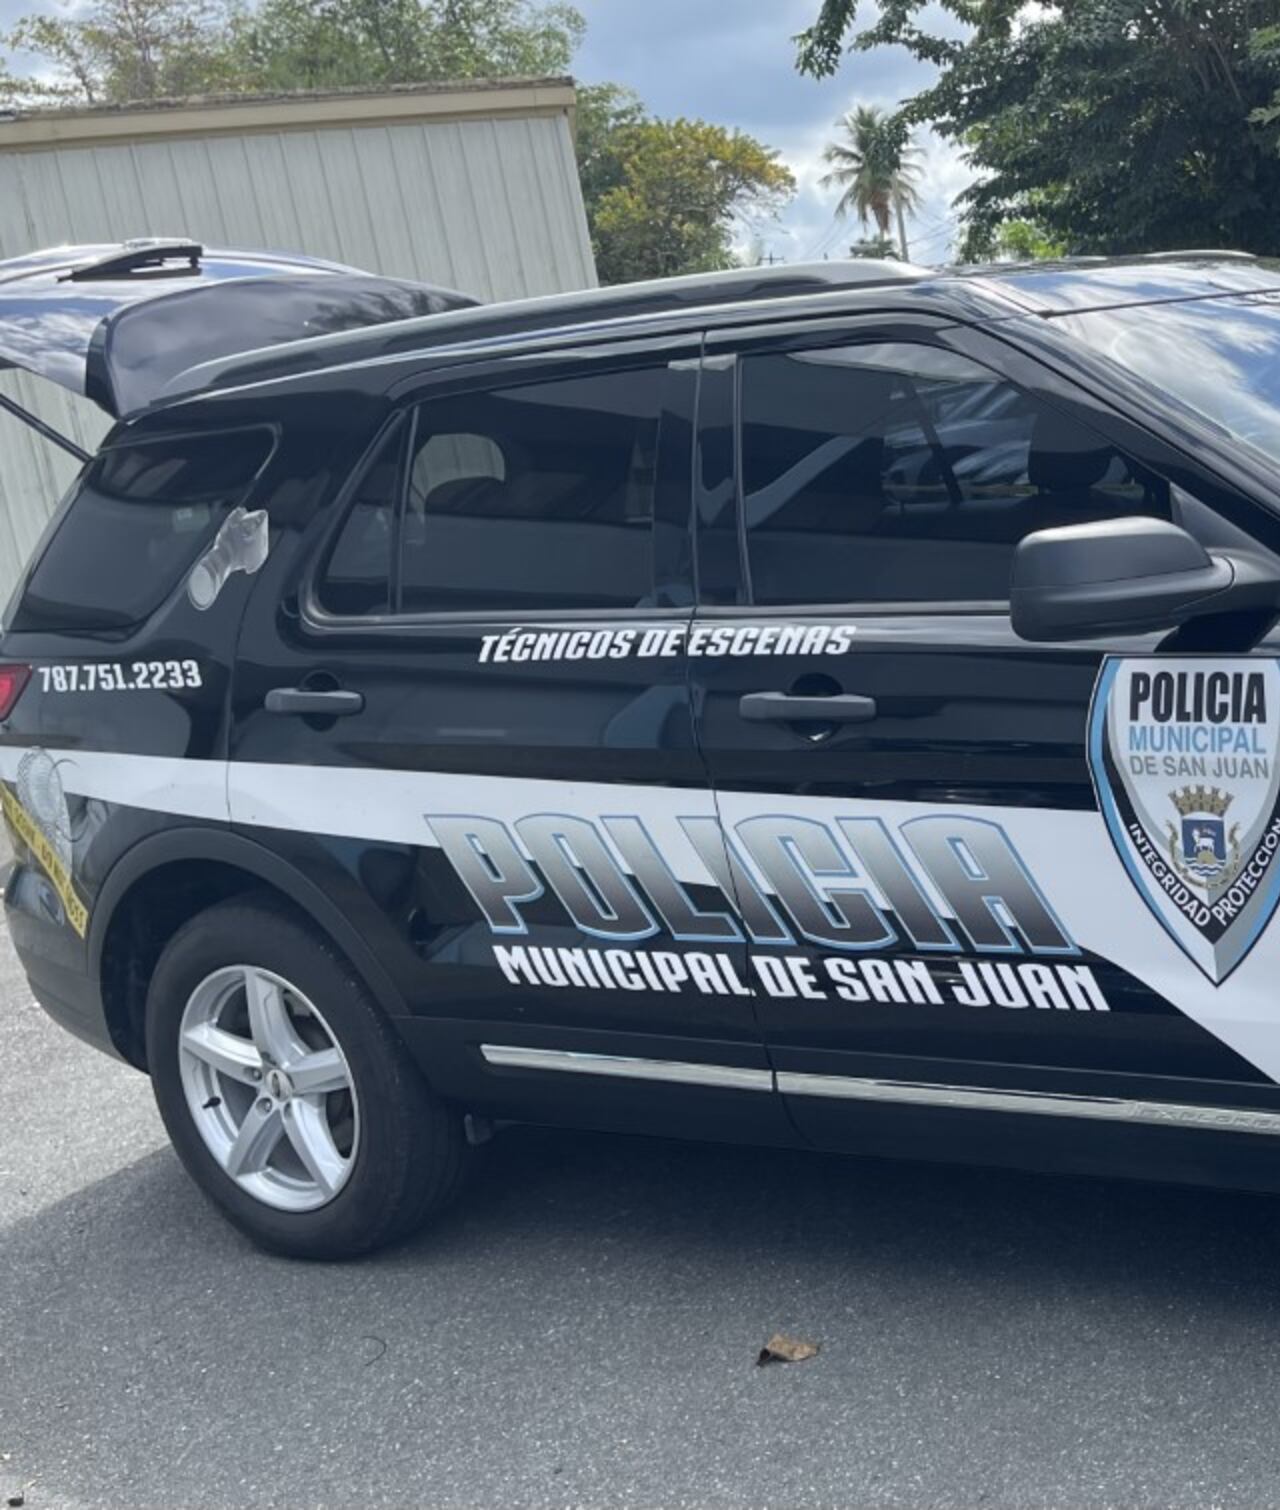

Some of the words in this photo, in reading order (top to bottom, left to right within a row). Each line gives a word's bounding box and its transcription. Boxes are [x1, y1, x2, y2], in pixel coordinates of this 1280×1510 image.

[478, 628, 635, 663] TÉCNICOS
[637, 629, 682, 658] DE
[688, 625, 857, 657] ESCENAS
[37, 660, 202, 693] 787.751.2233
[1129, 671, 1267, 724] POLICIA
[1129, 725, 1267, 754] MUNICIPAL
[1130, 755, 1159, 776] DE
[1164, 756, 1207, 778] SAN
[1213, 758, 1270, 780] JUAN
[423, 813, 1083, 955] POLICIA
[1129, 822, 1212, 928] INTEGRIDAD
[491, 945, 756, 997] MUNICIPAL
[750, 955, 828, 999] DE
[834, 958, 945, 1005] SAN
[949, 962, 1111, 1012] JUAN
